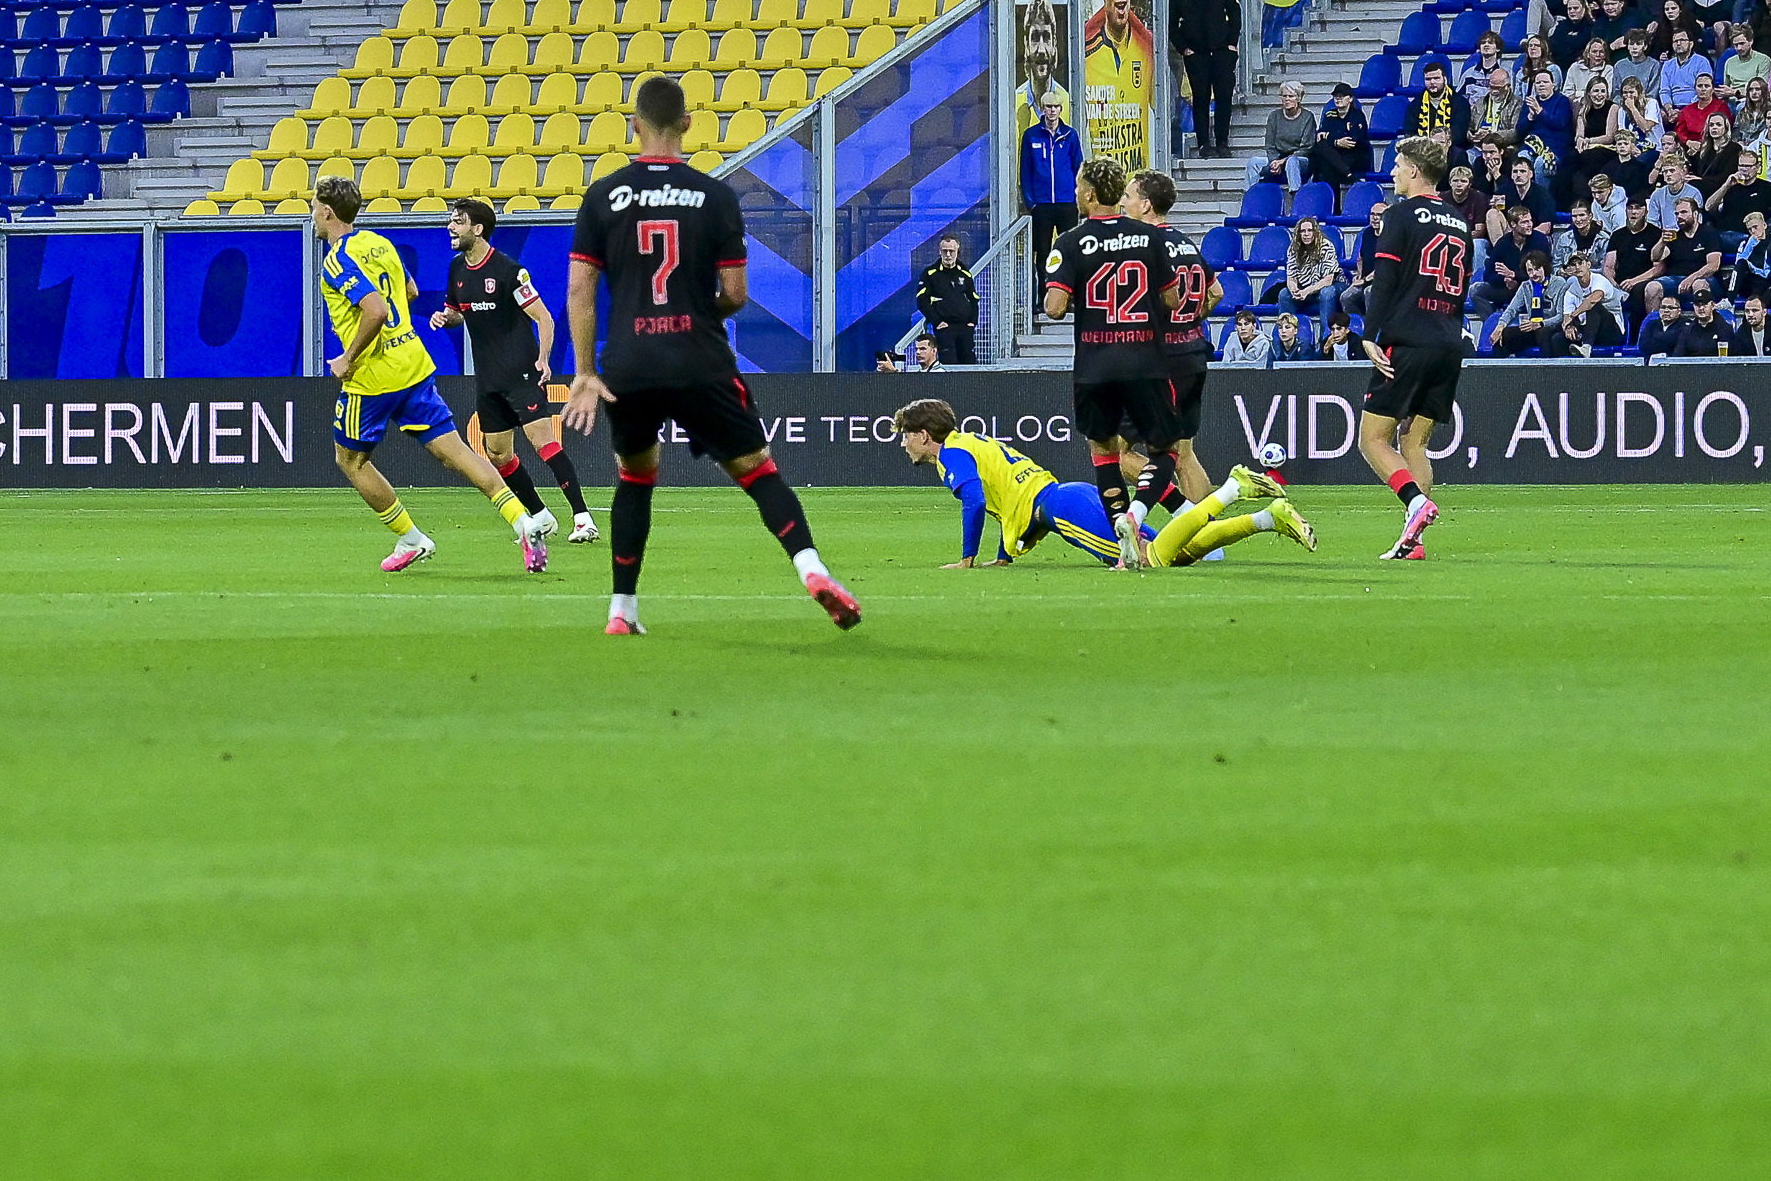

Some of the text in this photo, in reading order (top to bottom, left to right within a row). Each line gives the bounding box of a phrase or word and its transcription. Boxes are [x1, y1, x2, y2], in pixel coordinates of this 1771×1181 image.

[637, 219, 679, 306] 7
[1085, 260, 1149, 324] 42
[1418, 232, 1466, 297] 43
[1081, 330, 1154, 344] WEIDMANN
[1504, 390, 1765, 469] AUDIO,
